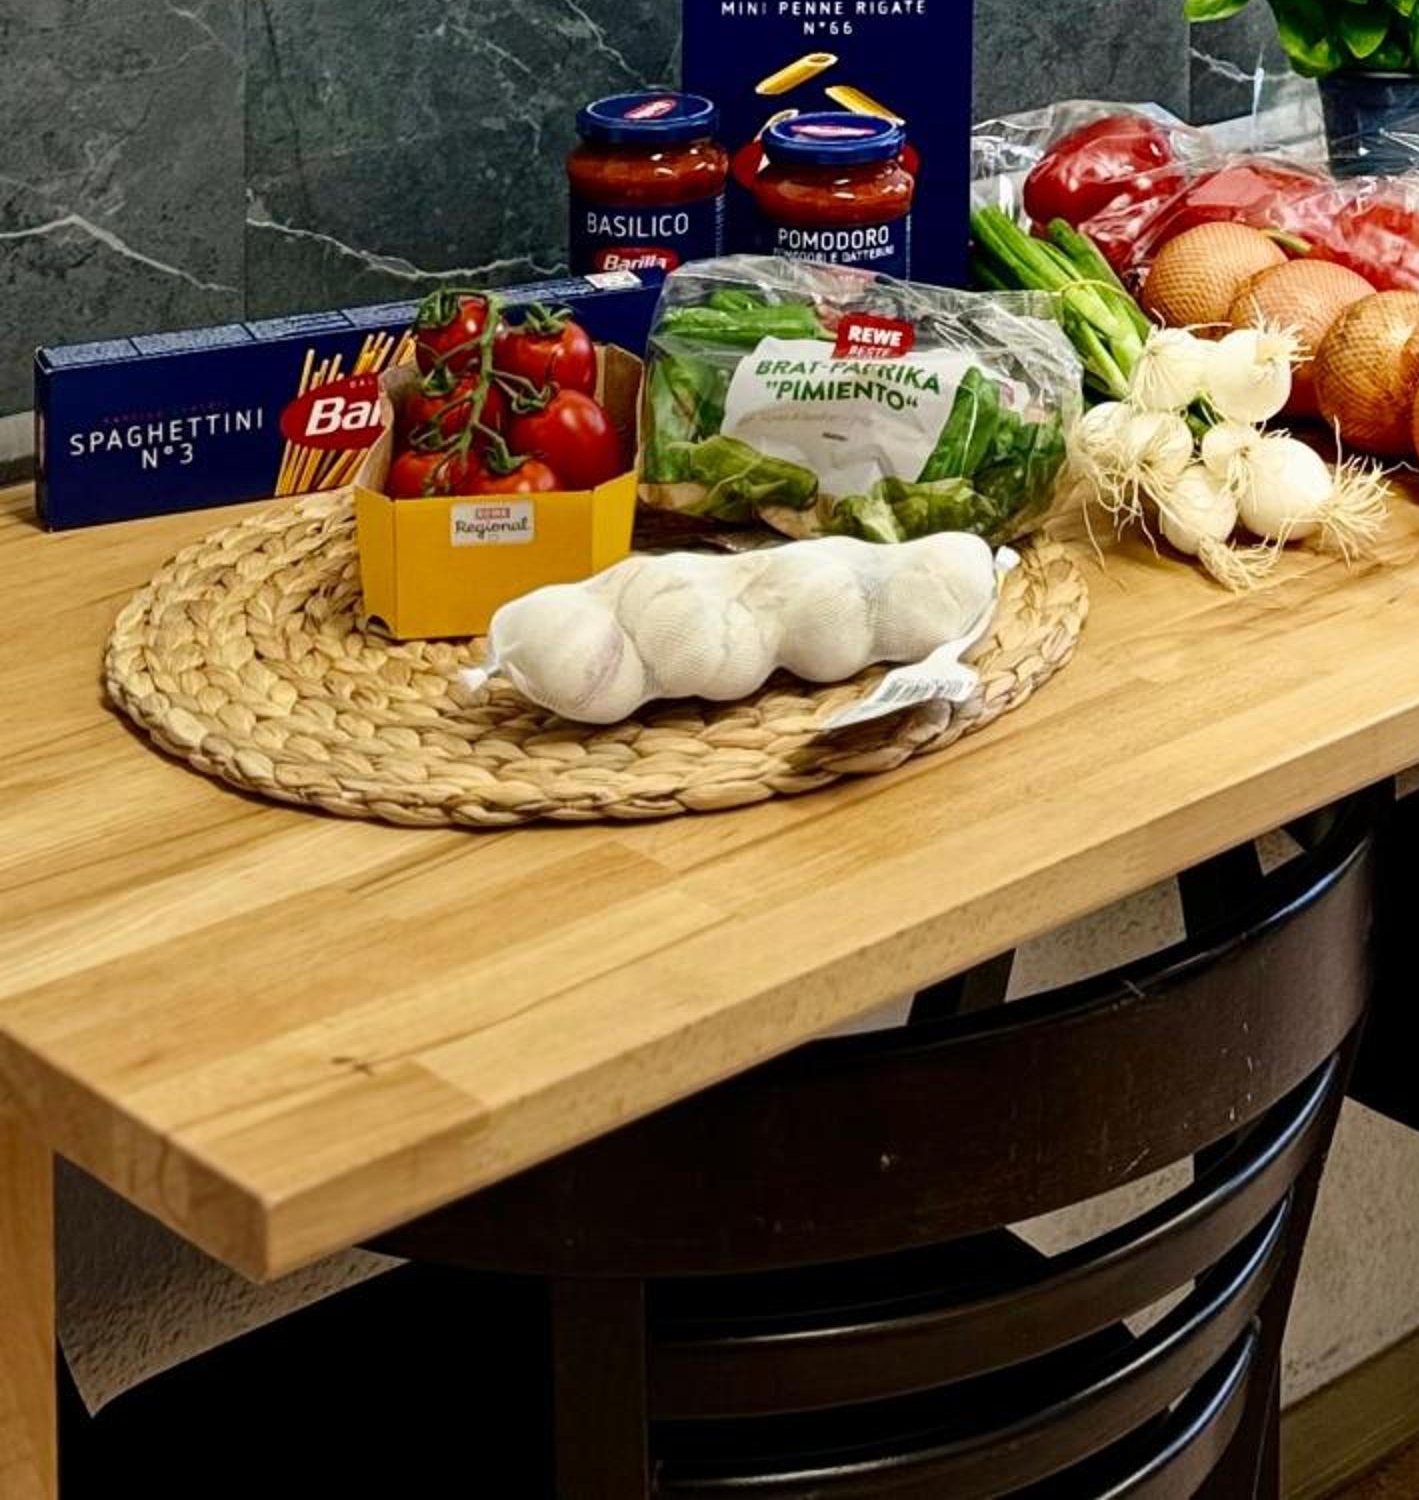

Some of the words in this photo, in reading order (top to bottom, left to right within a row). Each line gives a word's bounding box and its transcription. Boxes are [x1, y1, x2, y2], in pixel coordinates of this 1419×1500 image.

[720, 2, 767, 16] MINI
[778, 1, 844, 15] PENNE
[855, 0, 926, 15] RIGATE
[586, 211, 690, 238] BASILICO
[777, 225, 890, 251] POMODORO
[602, 253, 669, 271] Barilla
[848, 325, 903, 347] REWE
[69, 406, 263, 456] SPAGHETTINI
[141, 443, 194, 470] N°3
[455, 516, 530, 539] Regional
